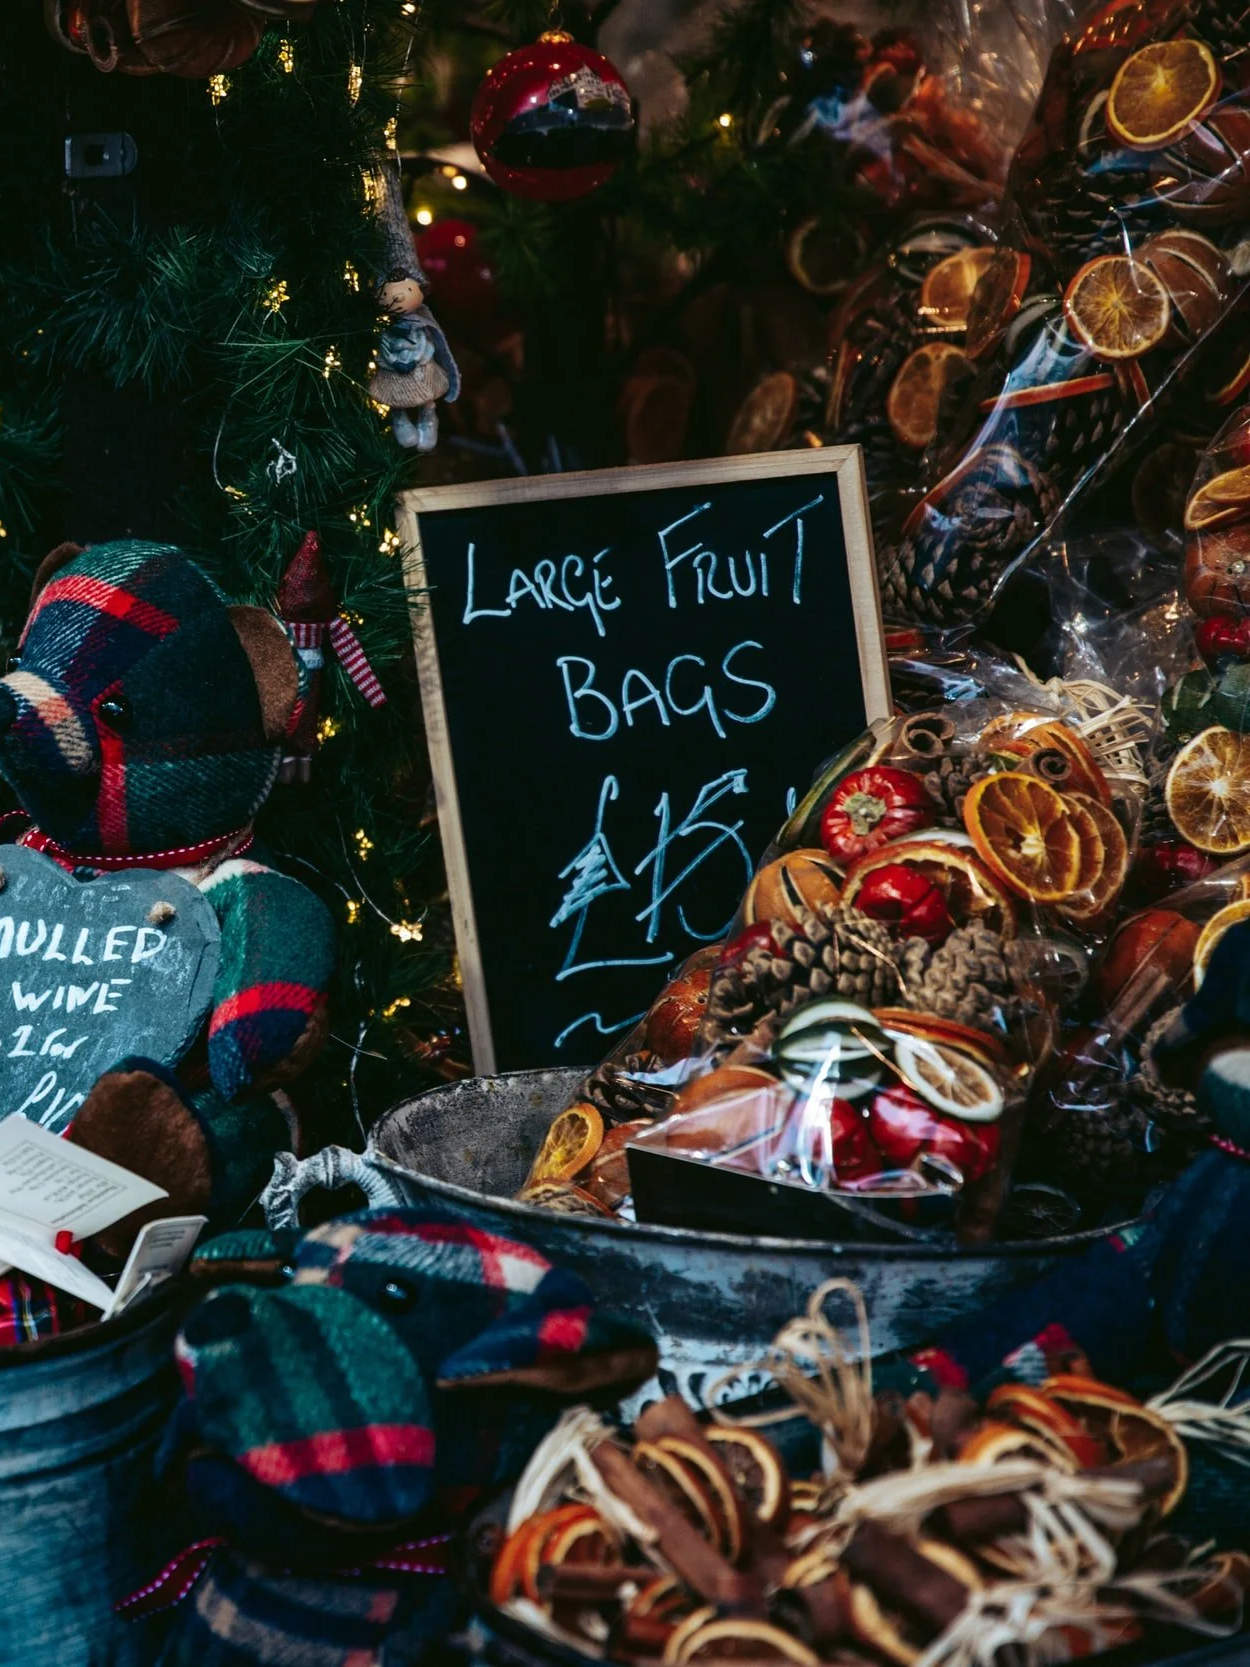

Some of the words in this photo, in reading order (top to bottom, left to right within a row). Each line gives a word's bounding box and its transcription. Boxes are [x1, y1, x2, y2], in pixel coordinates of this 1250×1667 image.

[463, 544, 621, 637] LARGE
[658, 495, 823, 608] FRUIT
[557, 640, 776, 740] BAGS
[12, 978, 133, 1015] WINE
